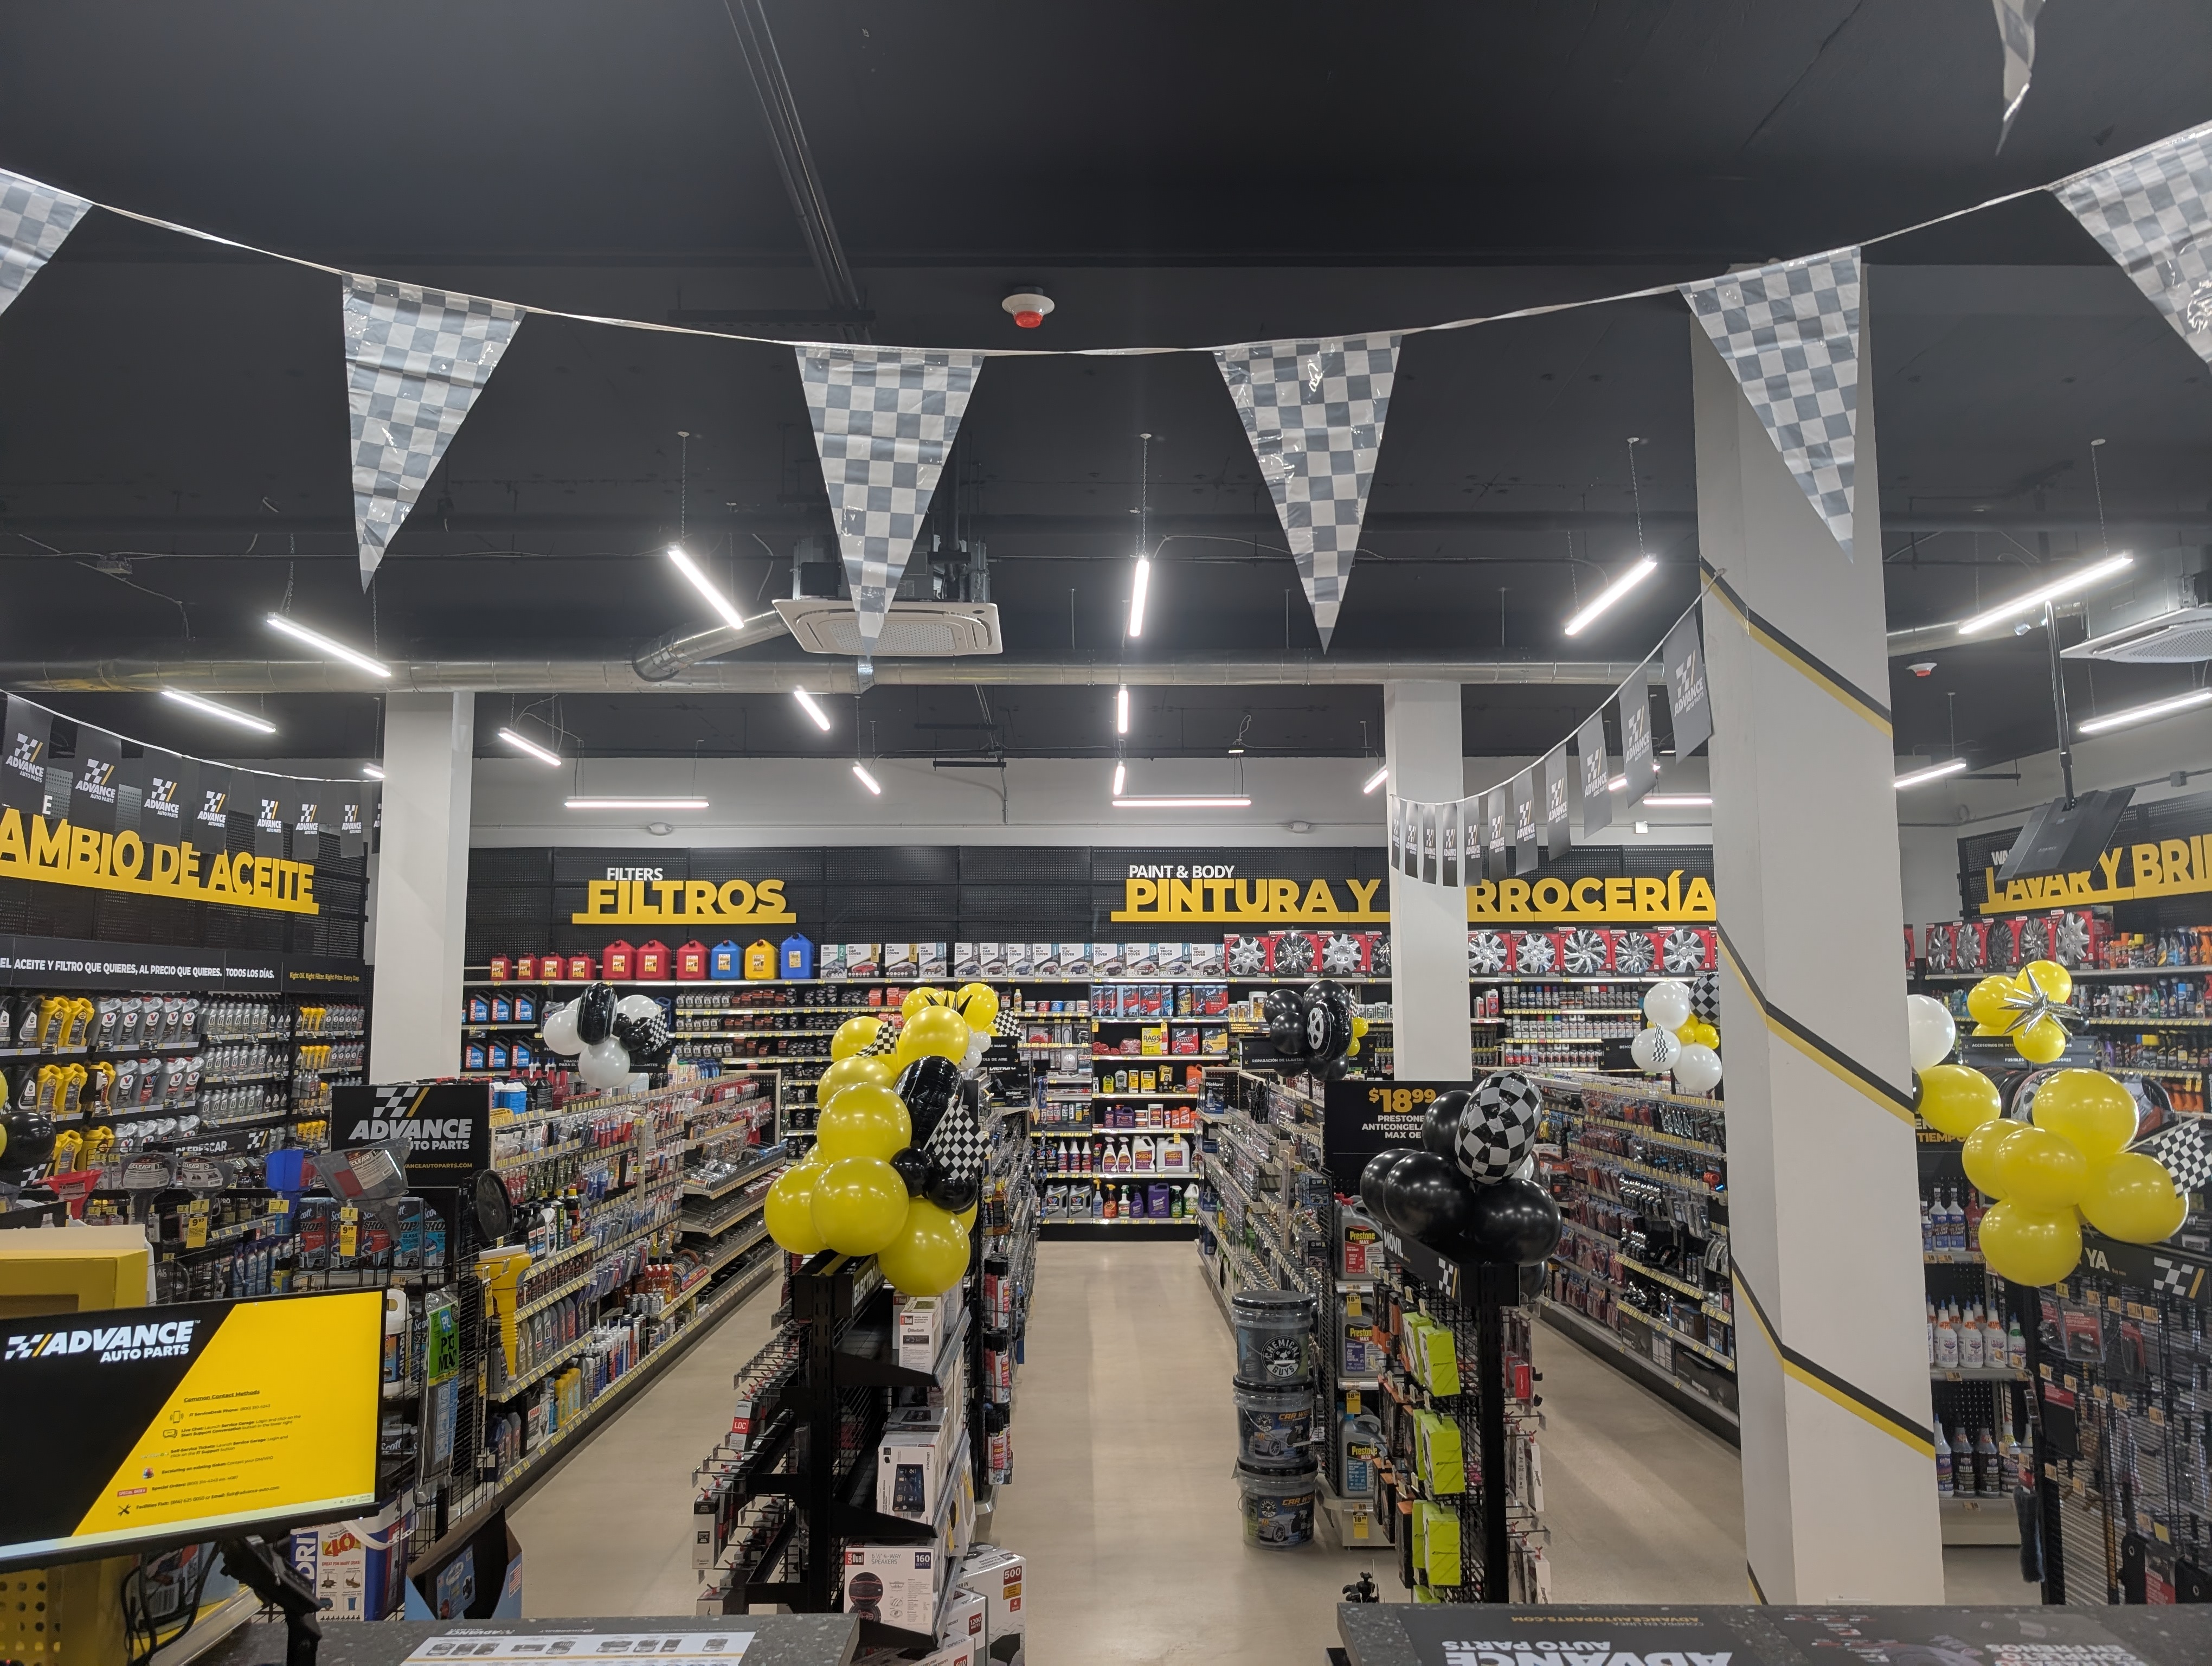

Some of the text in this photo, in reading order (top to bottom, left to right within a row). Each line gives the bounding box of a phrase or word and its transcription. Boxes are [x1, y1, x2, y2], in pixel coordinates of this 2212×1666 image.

[1674, 677, 1703, 717] ADVANCE
[1686, 693, 1704, 713] AUTO PARTS
[1626, 732, 1650, 764] ADVANCE
[5, 755, 44, 778] ADVANCE
[30, 774, 42, 783] PARTS
[1585, 772, 1607, 798] ADVANCE
[75, 780, 115, 798] ADVANCE
[101, 796, 114, 804] PARTS
[144, 798, 179, 813] ADVANCE
[197, 811, 226, 823] ADVANCE
[1548, 800, 1567, 822] ADVANCE
[257, 818, 282, 829] ADVANCE
[295, 822, 318, 831] ADVANCE
[342, 822, 362, 830] ADVANCE
[1517, 823, 1535, 840] ADVANCE
[1489, 837, 1504, 850] ADVANCE
[0, 808, 314, 905] AMBIO DE ACEITE
[2132, 834, 2212, 888] BRI
[607, 868, 663, 881] FILTERS
[1129, 865, 1234, 878] PAINT & BODY
[588, 880, 787, 915] FILTROS
[1126, 870, 1716, 913] PINTURA Y RROCERÍA
[0, 958, 274, 978] EL ACEITE Y FILTRO QUE QUIERES, AL PRECIO QUE QUIERES. TODOS LOS DÍAS.
[348, 1119, 473, 1140] ADVANCE
[408, 1140, 470, 1150] UTO PARTS
[351, 1154, 371, 1167] CLEAR
[1350, 1231, 1375, 1241] Prestone
[1384, 1228, 1404, 1259] MÓVIL
[2085, 1247, 2110, 1272] YA
[41, 1320, 194, 1356] ADVANCE
[1349, 1328, 1372, 1337] Preston
[100, 1344, 189, 1363] AUTO PARTS
[1264, 1337, 1299, 1360] CHEMICAL
[1272, 1365, 1295, 1376] GUYS
[184, 1395, 210, 1403] Common
[1278, 1412, 1295, 1421] CAR
[734, 1421, 747, 1430] LOC
[1282, 1498, 1300, 1506] CAR
[852, 1553, 863, 1564] Dual
[1004, 1567, 1021, 1579] 500
[970, 1616, 981, 1625] 1200
[1442, 1641, 1610, 1651] AUTO PARTS
